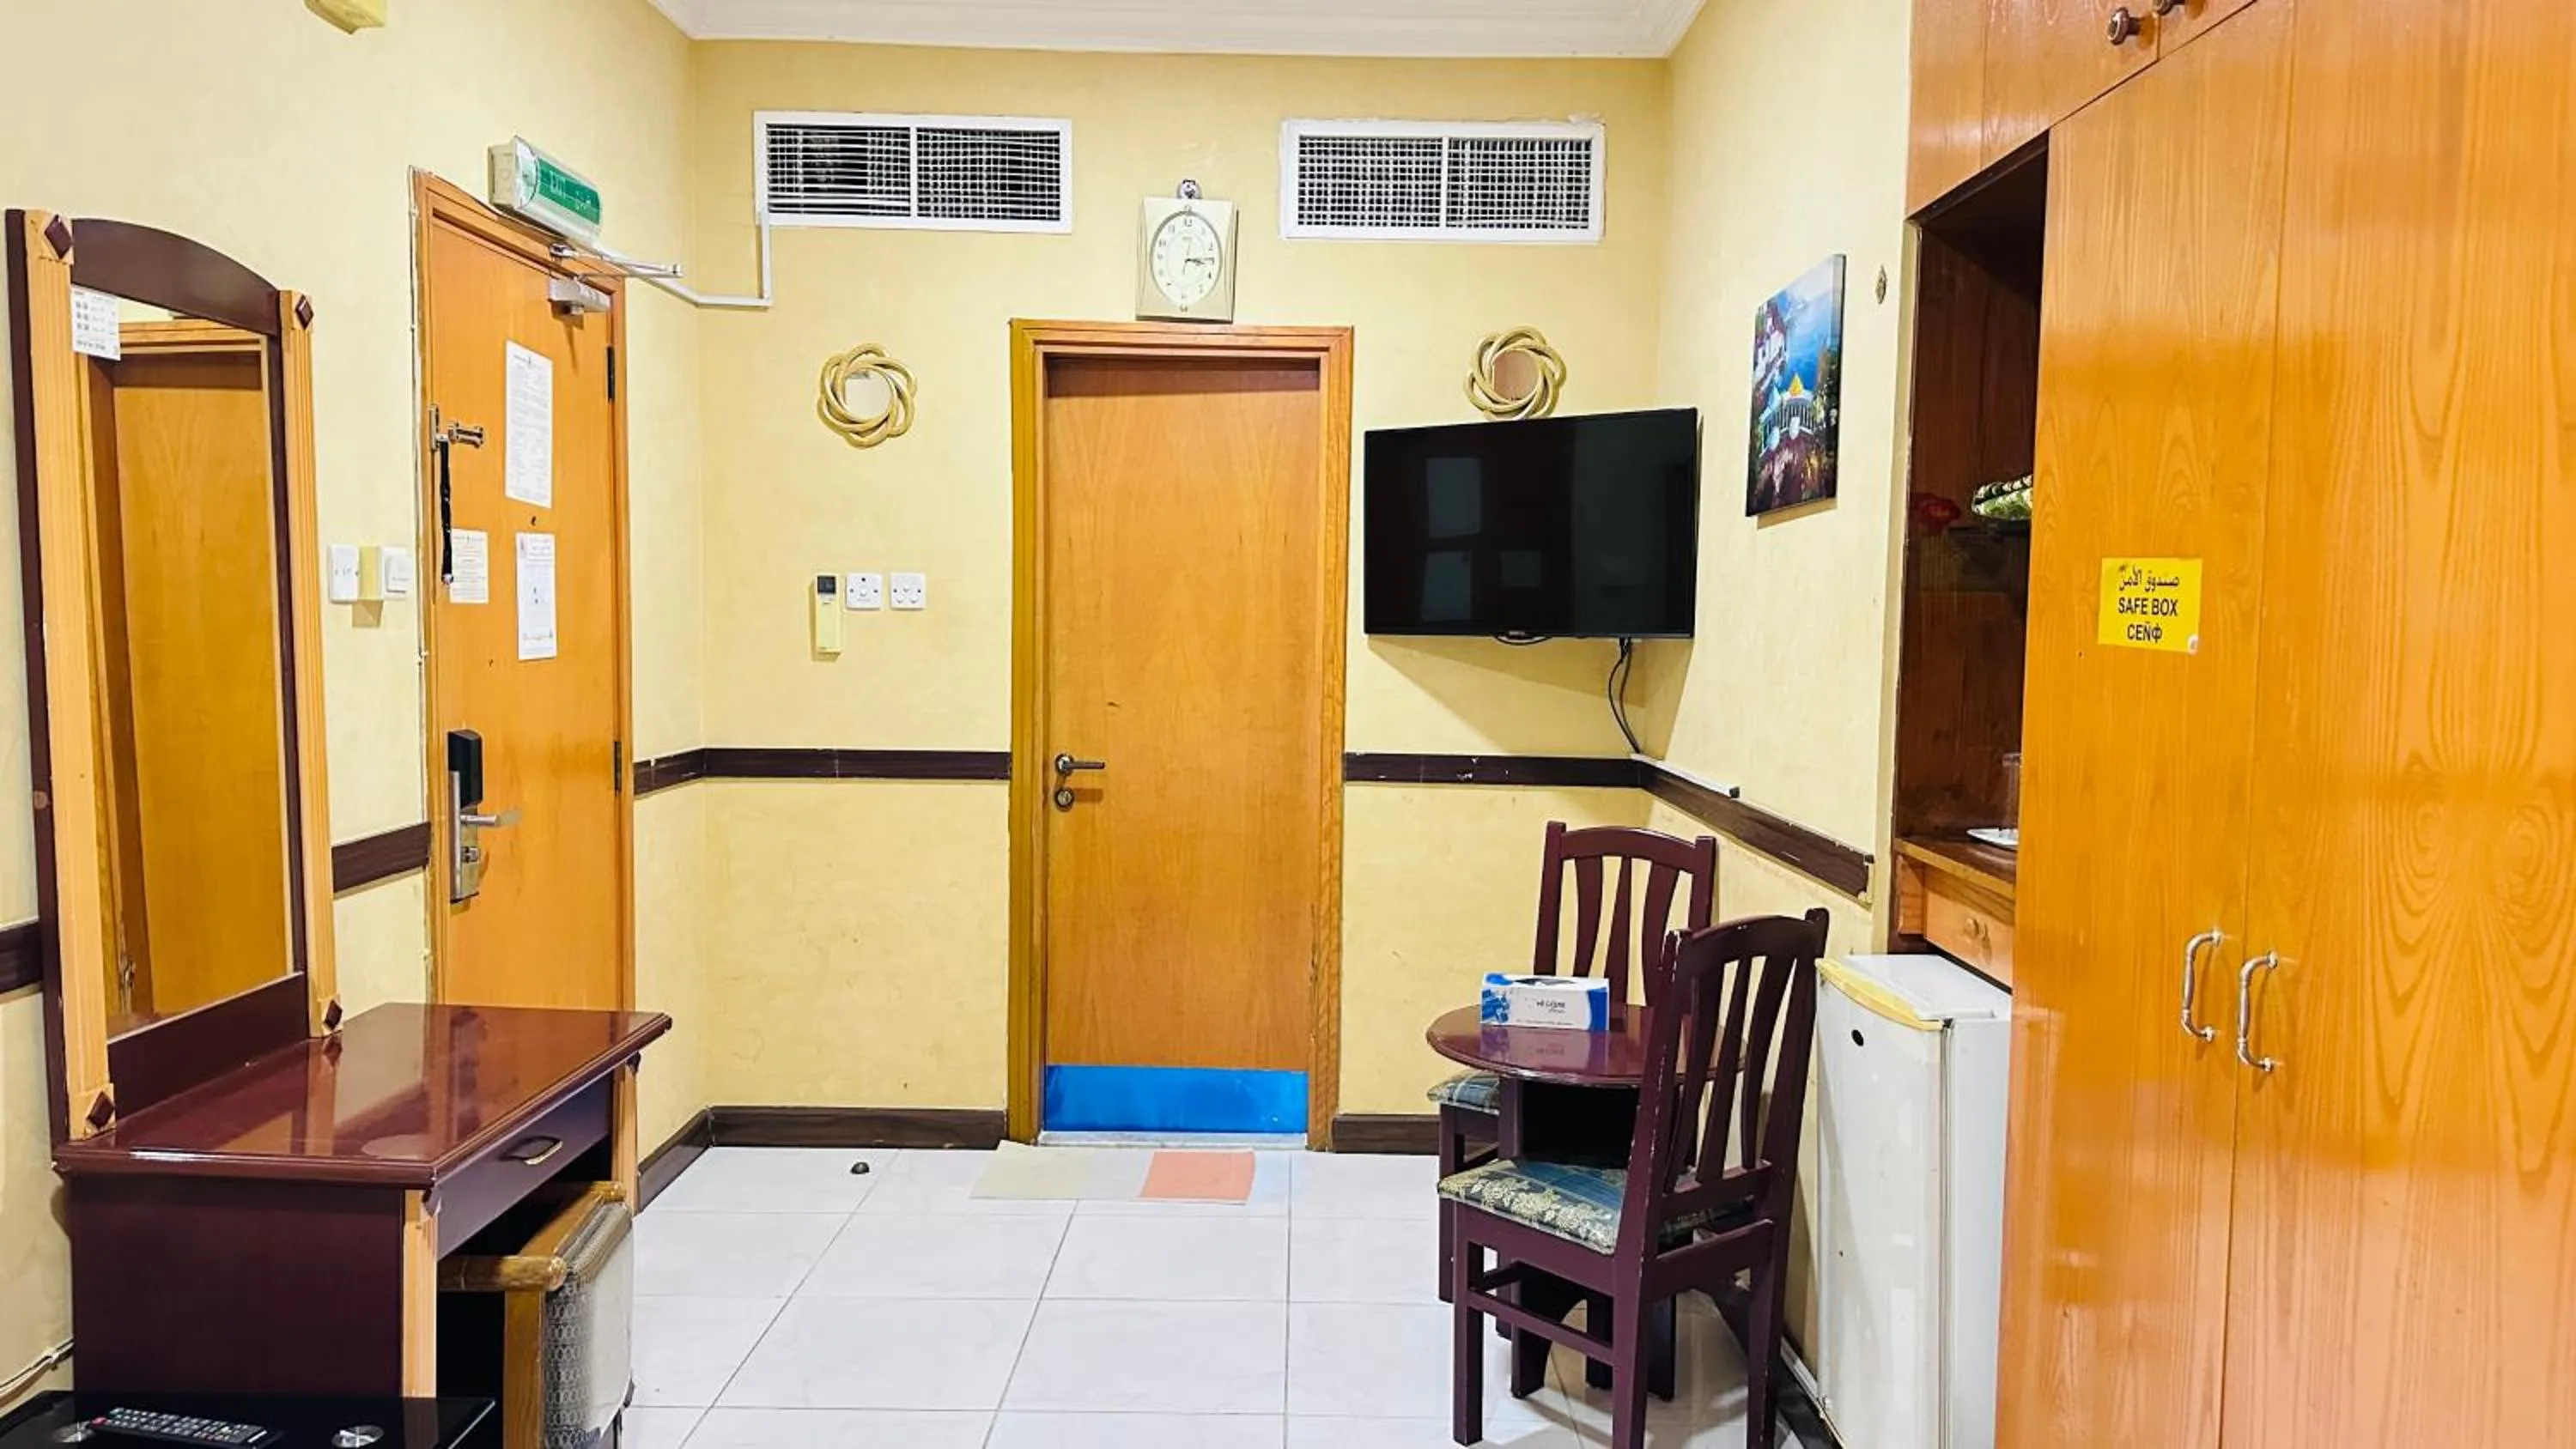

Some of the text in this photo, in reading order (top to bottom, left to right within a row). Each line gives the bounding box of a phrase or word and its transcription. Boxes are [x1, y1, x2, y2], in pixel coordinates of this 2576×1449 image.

[2145, 570, 2180, 592] صندوق
[2117, 597, 2178, 616] SAFE BOX
